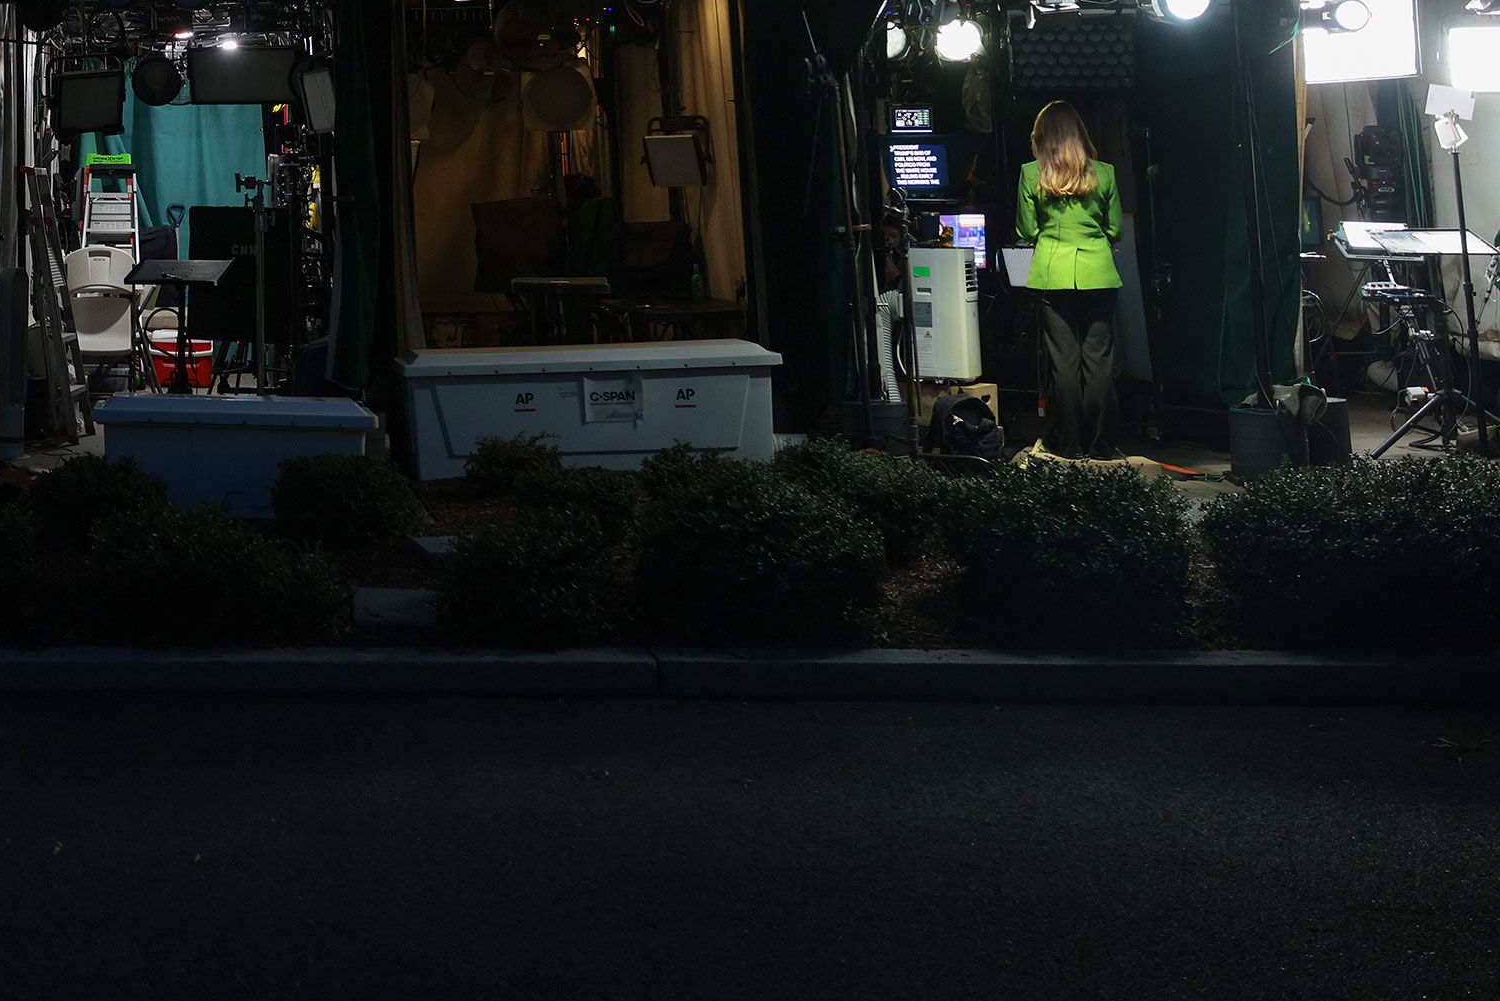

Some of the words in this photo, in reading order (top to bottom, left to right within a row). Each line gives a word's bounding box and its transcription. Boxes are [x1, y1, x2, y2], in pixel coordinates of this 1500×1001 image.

[231, 244, 257, 256] CNN
[515, 392, 534, 406] AP
[676, 388, 695, 401] AP
